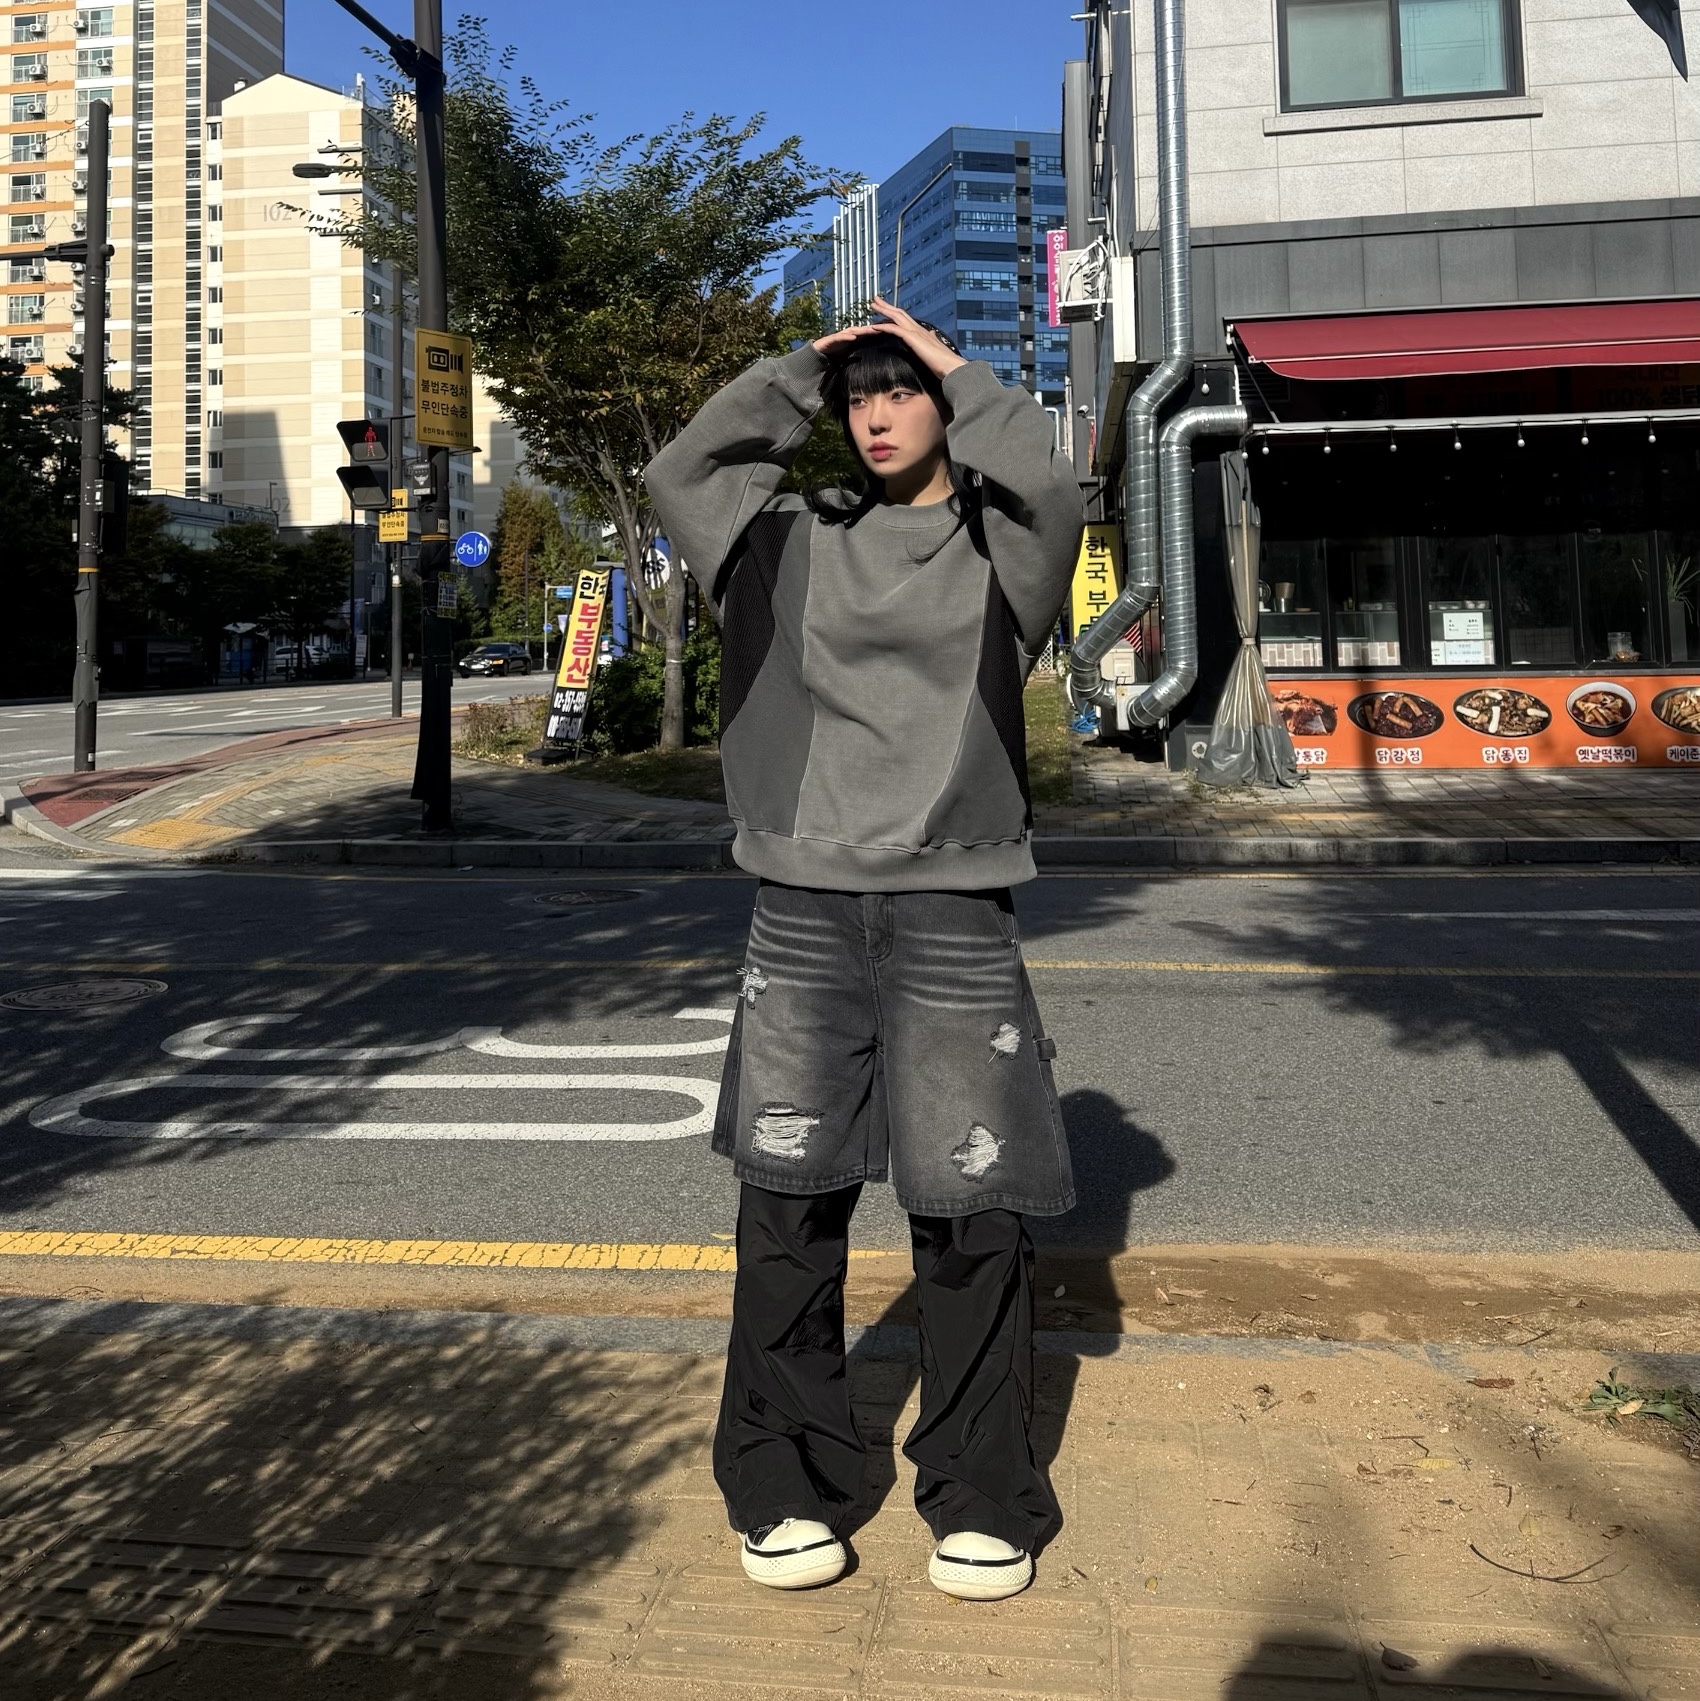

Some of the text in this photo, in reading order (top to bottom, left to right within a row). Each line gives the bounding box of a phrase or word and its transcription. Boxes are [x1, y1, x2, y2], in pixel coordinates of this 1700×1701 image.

[421, 379, 468, 399] 불법주정차
[421, 400, 468, 419] 무인단속중
[566, 602, 601, 684] 부동산
[1578, 748, 1637, 761] 옛날떡볶이
[1669, 747, 1700, 760] 케이준
